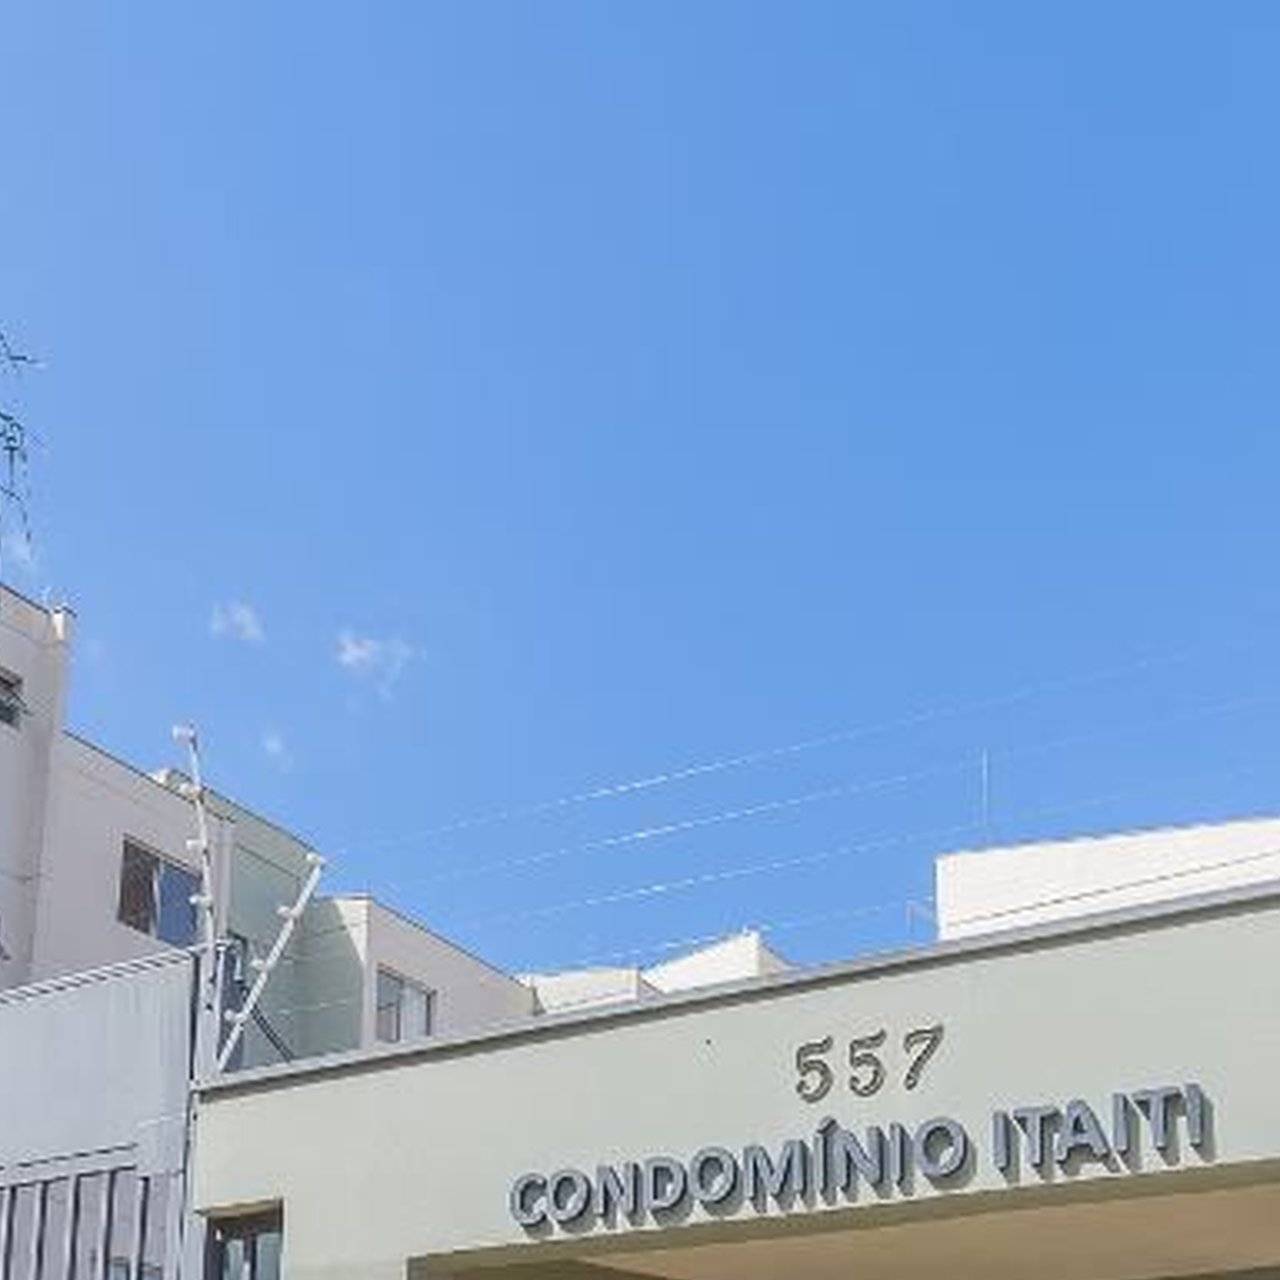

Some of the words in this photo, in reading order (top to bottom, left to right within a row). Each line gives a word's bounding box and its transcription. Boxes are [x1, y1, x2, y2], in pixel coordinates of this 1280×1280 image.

[795, 1025, 944, 1099] 557
[509, 1116, 971, 1234] CONDOMÍNIO
[992, 1084, 1217, 1171] ITAITI
